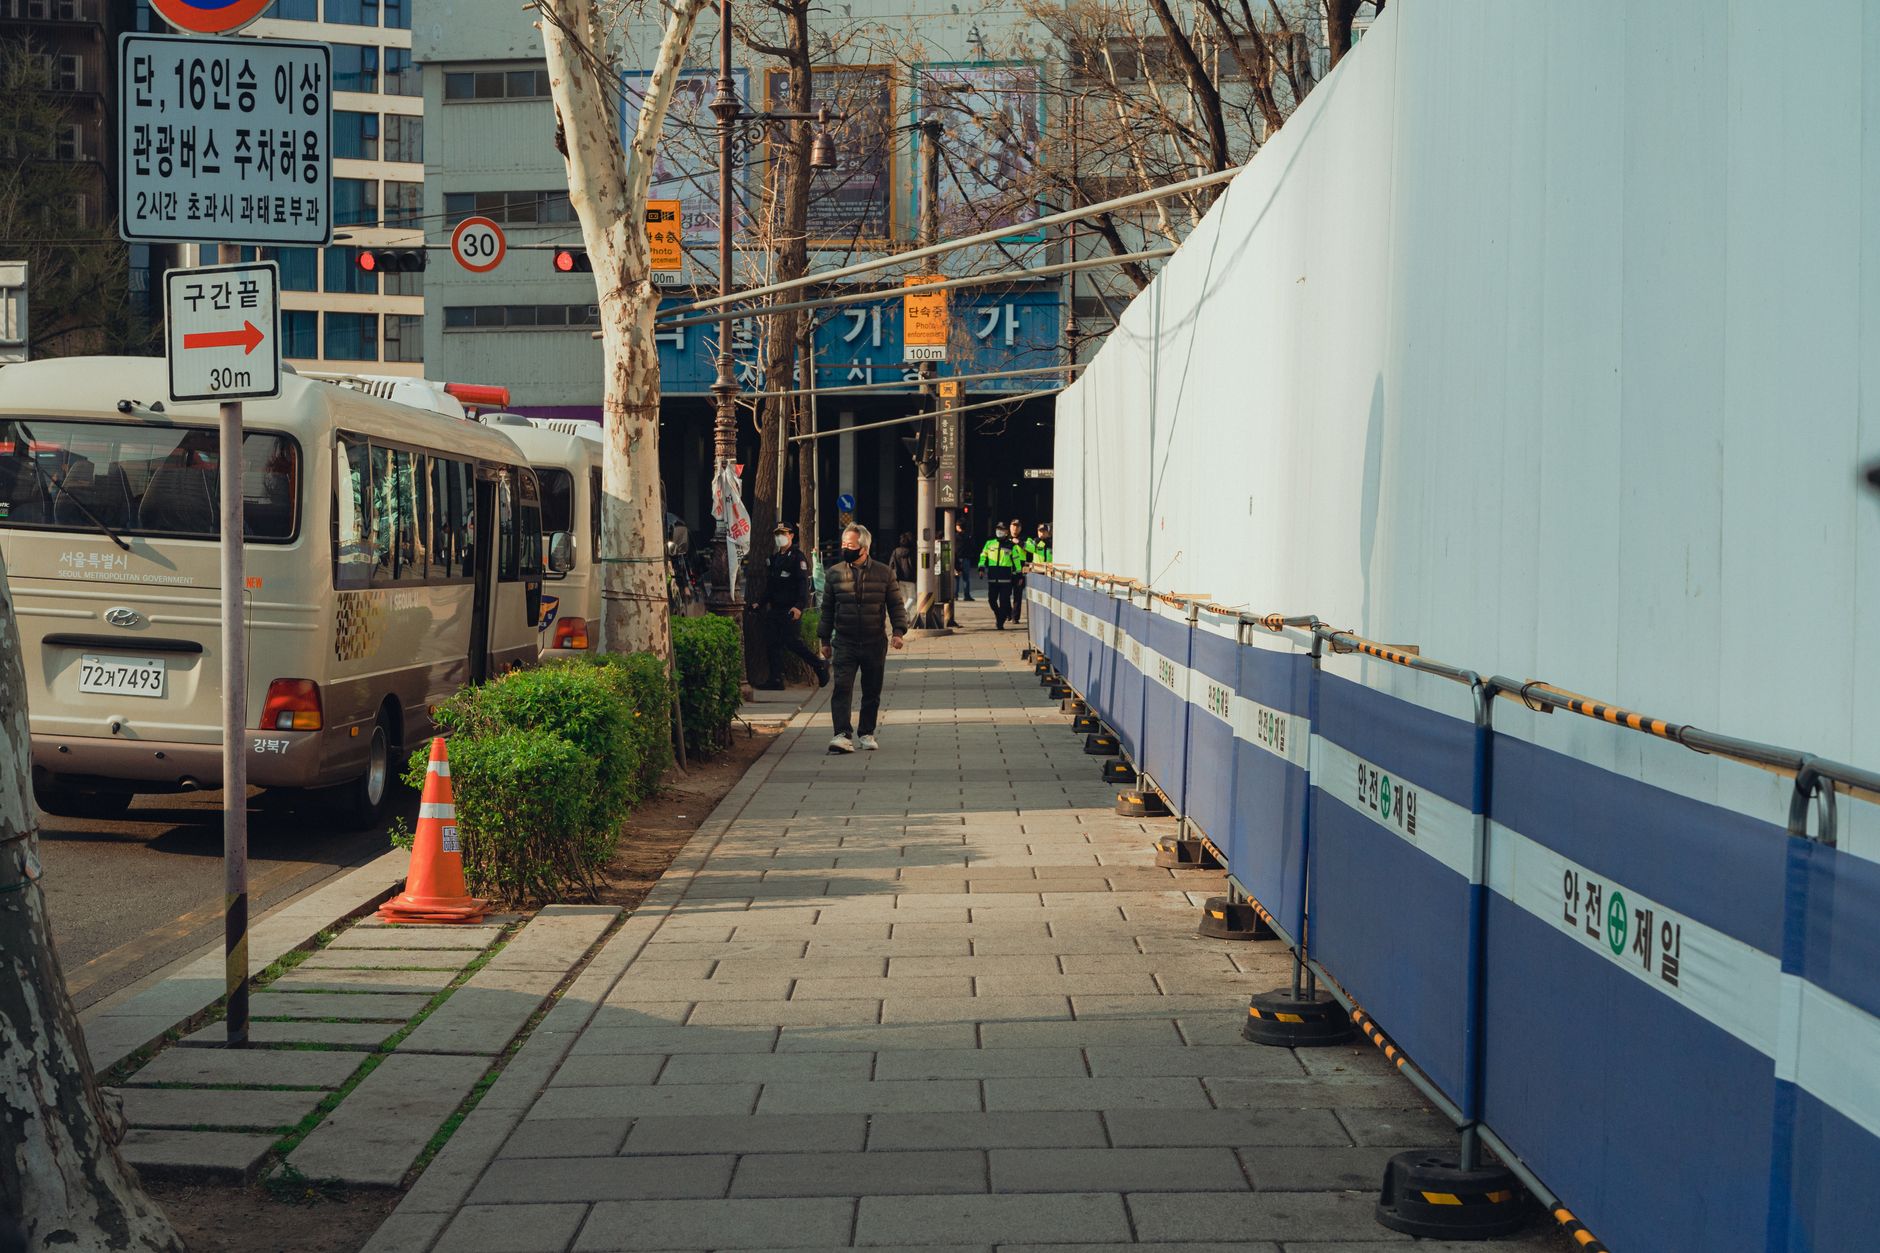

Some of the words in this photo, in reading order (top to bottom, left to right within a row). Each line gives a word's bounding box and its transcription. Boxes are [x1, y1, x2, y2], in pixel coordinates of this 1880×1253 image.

[274, 61, 321, 116] 이상
[133, 123, 220, 179] 관광버스
[234, 128, 320, 184] 주차허용
[136, 191, 178, 221] 2시간
[187, 192, 233, 223] 초과시
[240, 194, 319, 226] 과태료부과
[463, 233, 495, 257] 30
[910, 348, 943, 359] 100m
[210, 367, 251, 391] 30m
[59, 551, 128, 570] 서울특별시
[58, 570, 82, 578] SEOUL
[84, 571, 140, 581] METROPOLITAN
[143, 574, 194, 584] GOVERNMENT
[246, 576, 263, 589] NEW
[82, 665, 161, 690] 72거7493
[253, 738, 290, 754] 강북7
[1358, 763, 1378, 811] 안전
[1393, 784, 1417, 836] 제일
[1563, 868, 1602, 940] 안전
[1632, 907, 1681, 988] 제일
